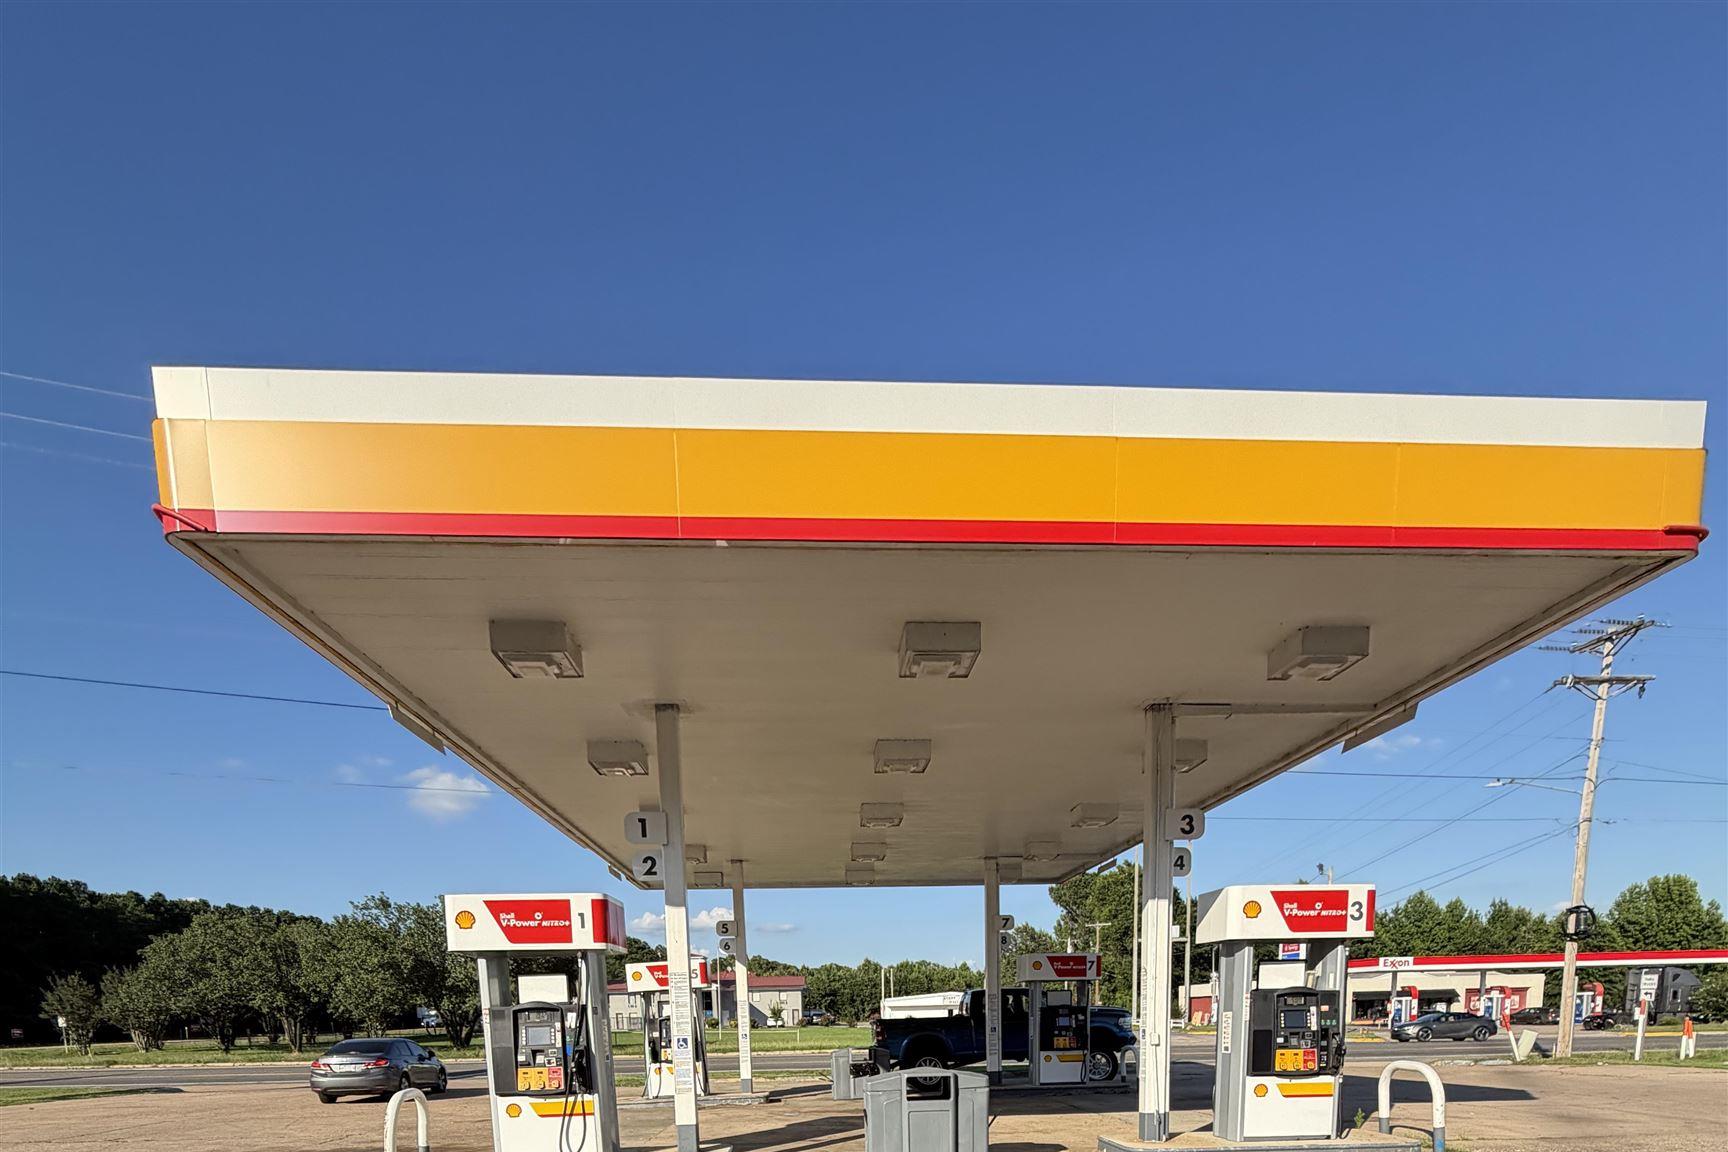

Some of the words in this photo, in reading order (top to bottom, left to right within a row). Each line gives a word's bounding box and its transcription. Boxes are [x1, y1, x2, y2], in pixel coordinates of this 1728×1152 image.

[638, 818, 647, 838] 1
[1180, 814, 1195, 835] 3
[642, 856, 658, 876] 2
[1173, 855, 1185, 871] 4
[1284, 909, 1318, 917] V-Power
[1350, 901, 1363, 921] 3
[501, 919, 540, 928] V-Power
[578, 912, 586, 929] 1
[1002, 917, 1010, 929] 7
[721, 923, 729, 934] 5
[723, 941, 731, 951] 6
[1001, 935, 1007, 945] 8
[1088, 960, 1096, 971] 7
[1383, 958, 1410, 970] Exxon
[691, 968, 699, 979] 5
